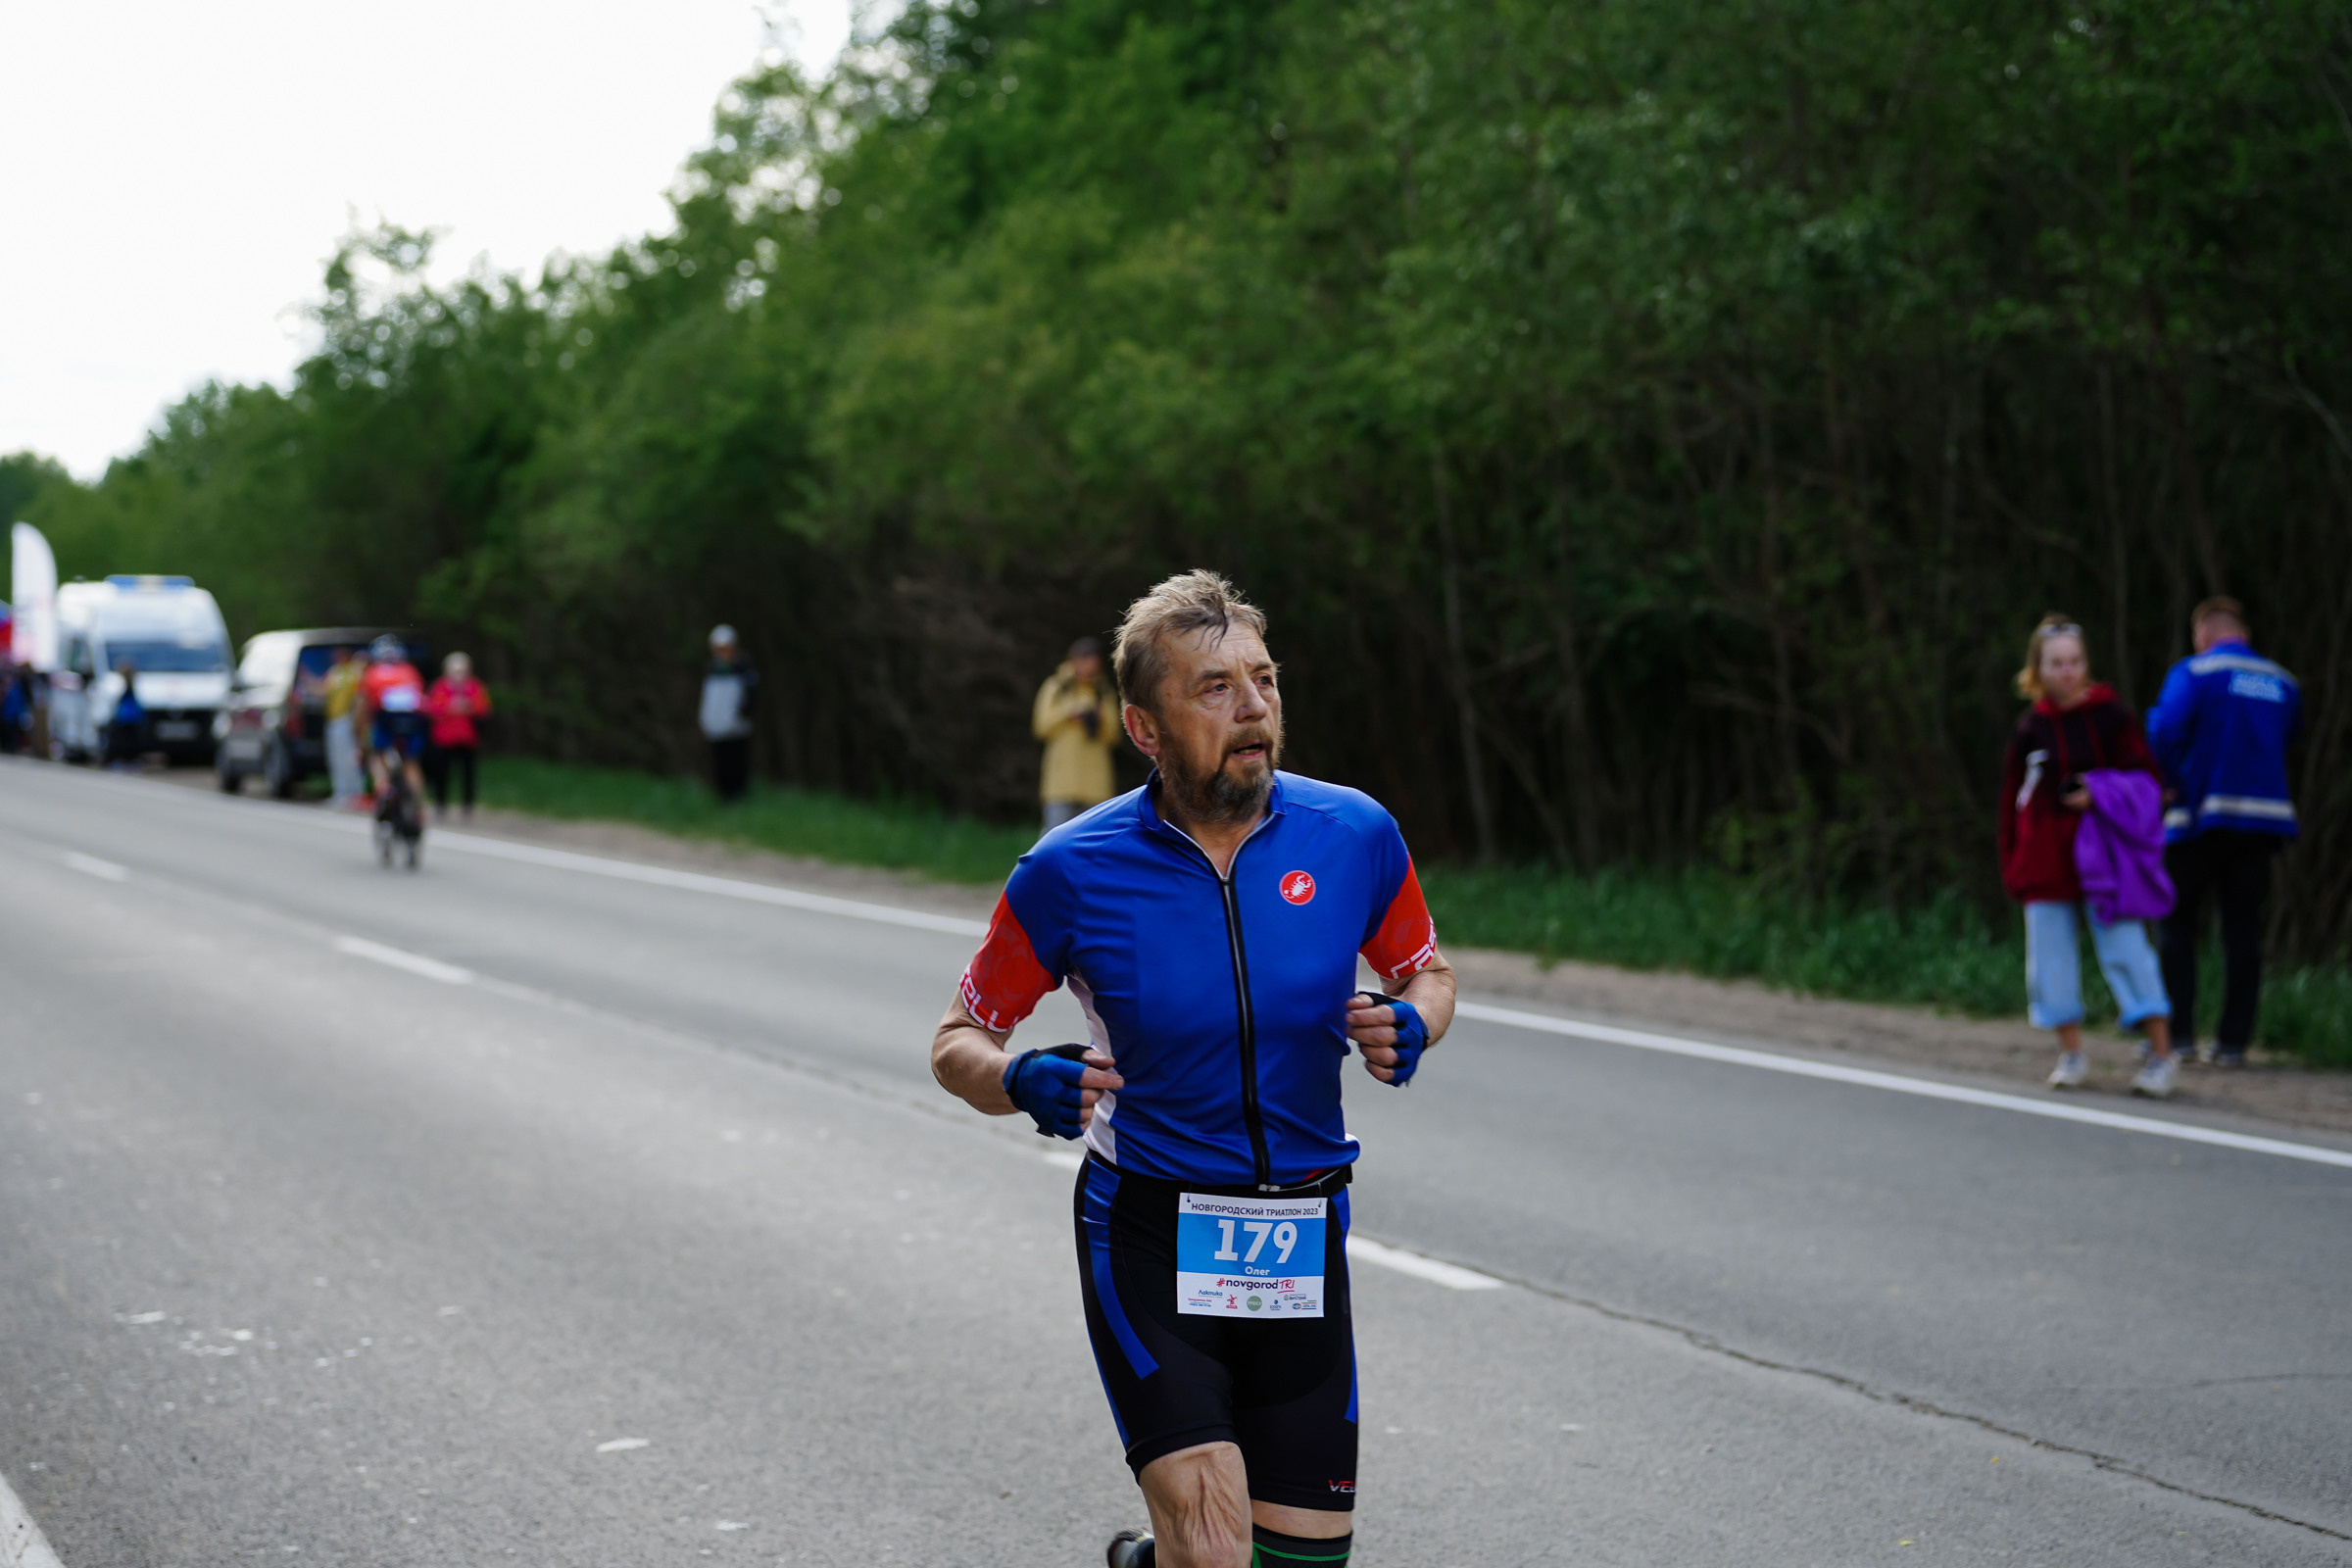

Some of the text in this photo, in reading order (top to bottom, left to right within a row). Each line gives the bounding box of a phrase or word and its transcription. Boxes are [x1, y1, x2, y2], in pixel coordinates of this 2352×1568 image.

[1192, 1202, 1264, 1216] НОВГОРОДСКИЙ
[1214, 1218, 1298, 1264] 179
[1245, 1266, 1270, 1276] Олег
